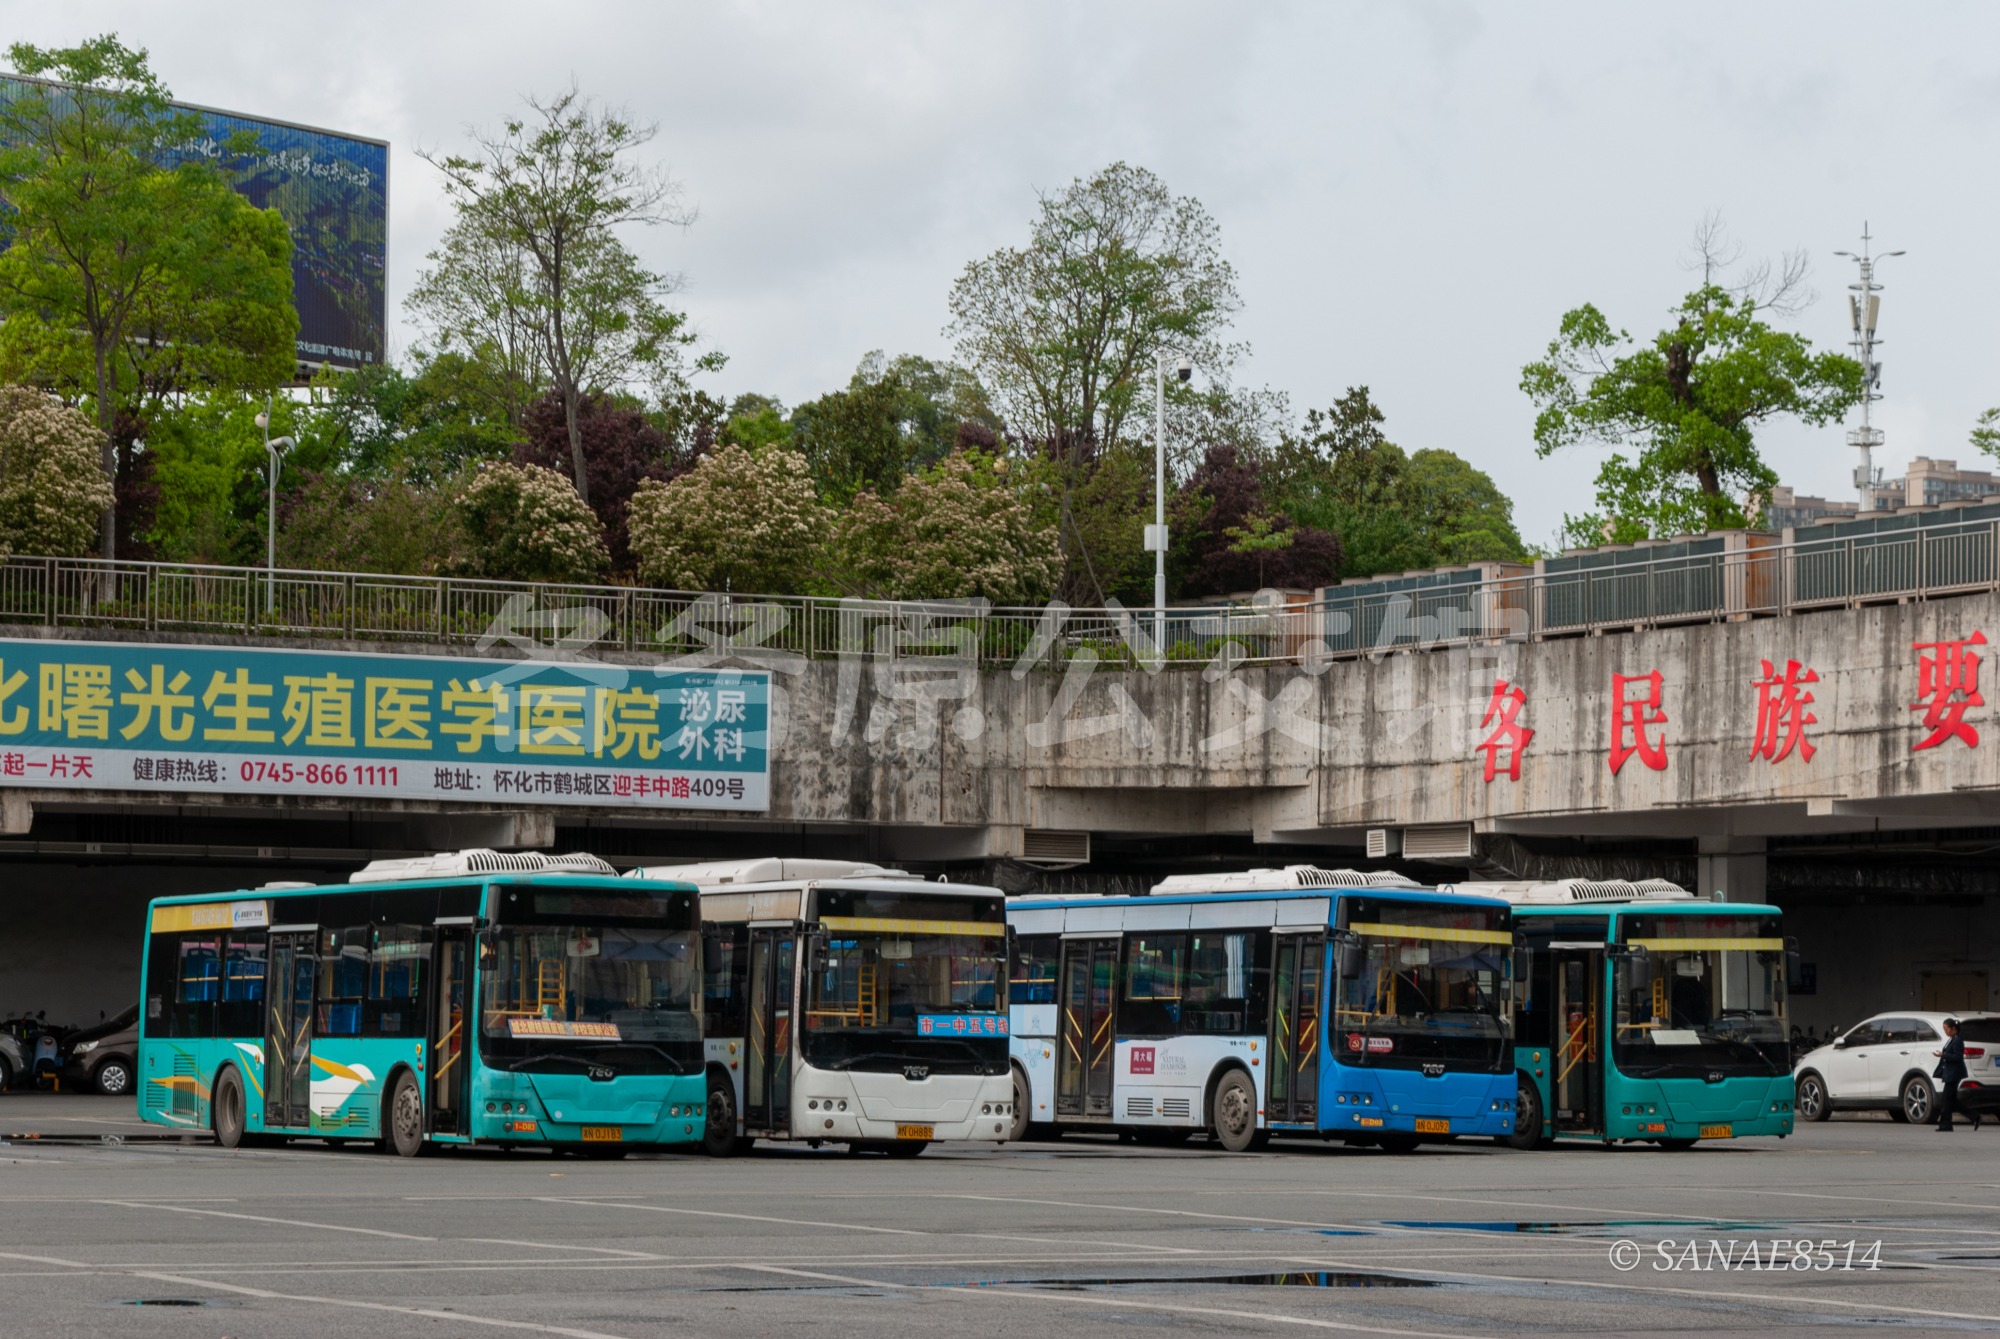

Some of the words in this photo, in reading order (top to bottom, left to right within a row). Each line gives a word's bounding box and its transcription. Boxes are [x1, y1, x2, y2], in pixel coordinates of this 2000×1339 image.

[679, 687, 747, 724] 泌尿
[678, 726, 747, 762] 外科
[0, 752, 94, 779] 起一片天
